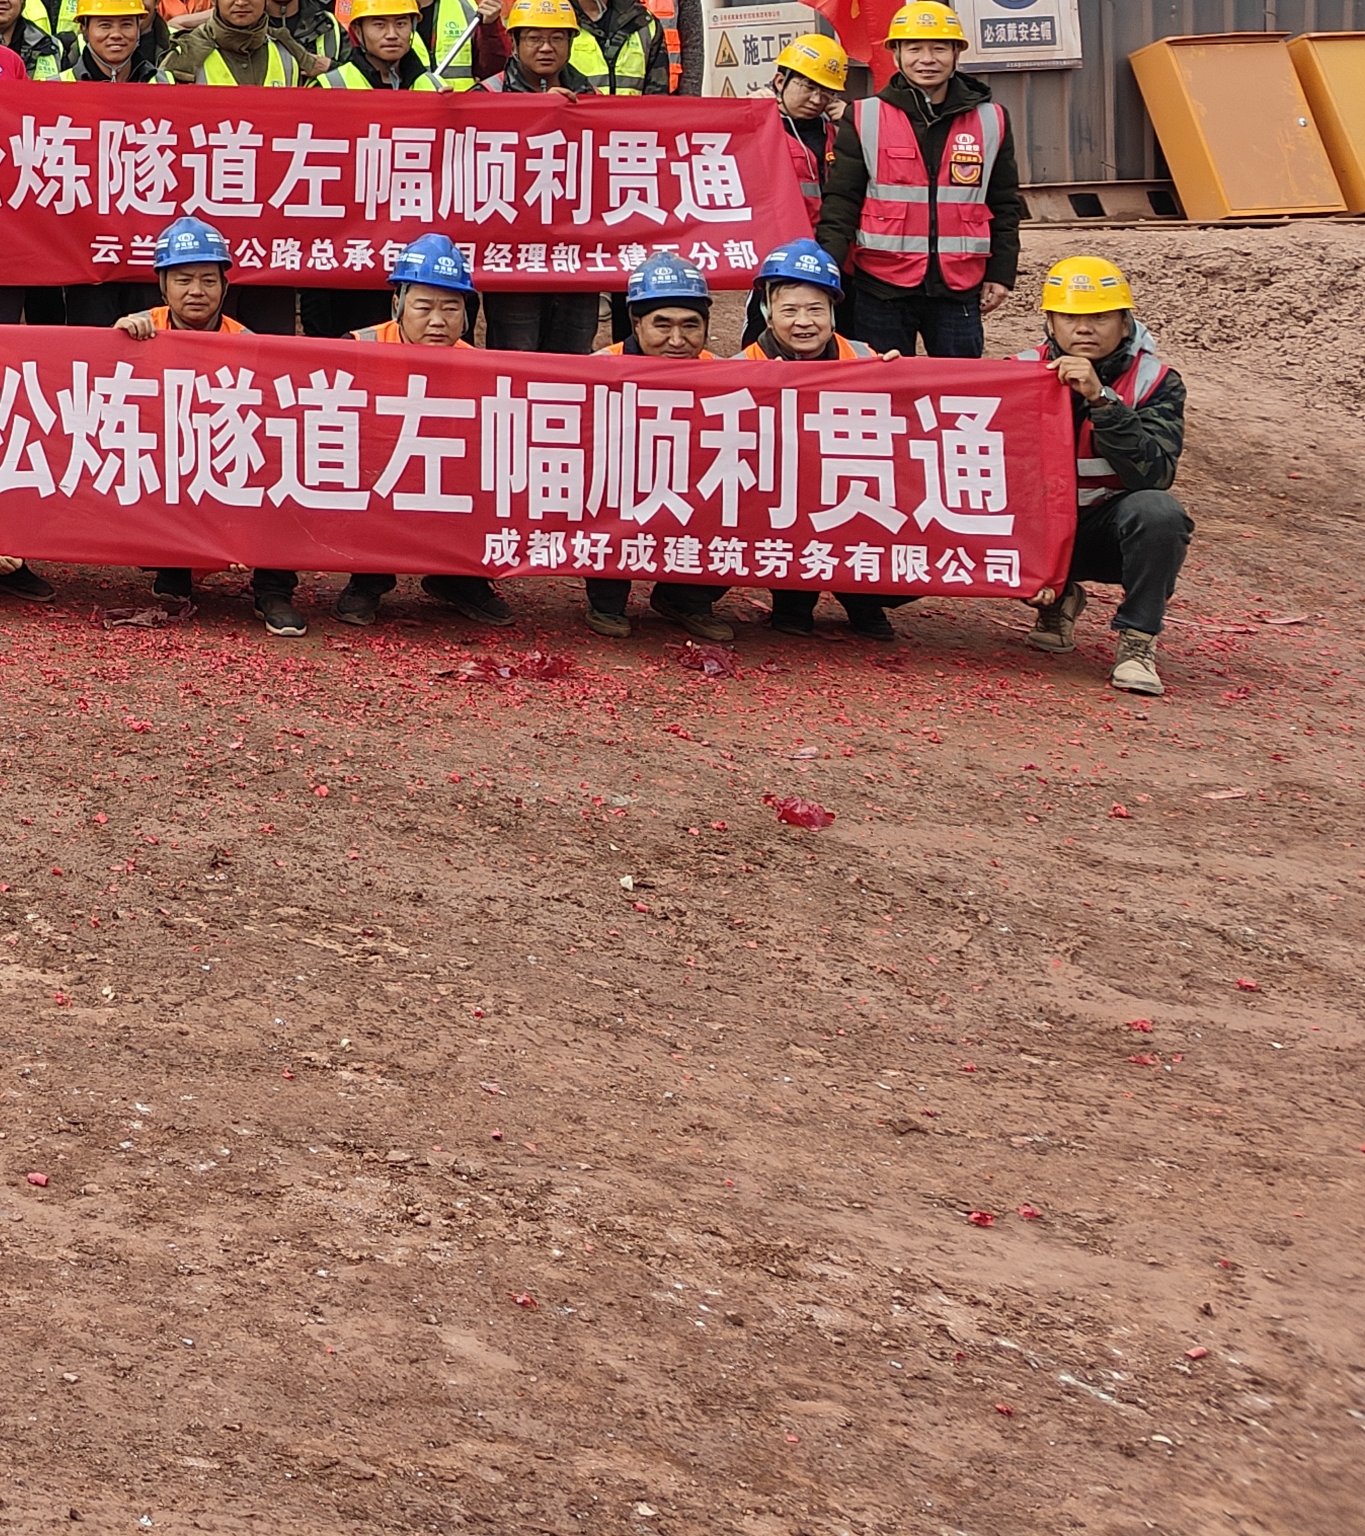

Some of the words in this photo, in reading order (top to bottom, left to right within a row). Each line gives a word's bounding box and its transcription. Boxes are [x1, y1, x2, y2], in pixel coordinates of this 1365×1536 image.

[983, 20, 1053, 44] 必须戴安全帽
[482, 524, 1023, 589] 成都好成建筑劳务有限公司
